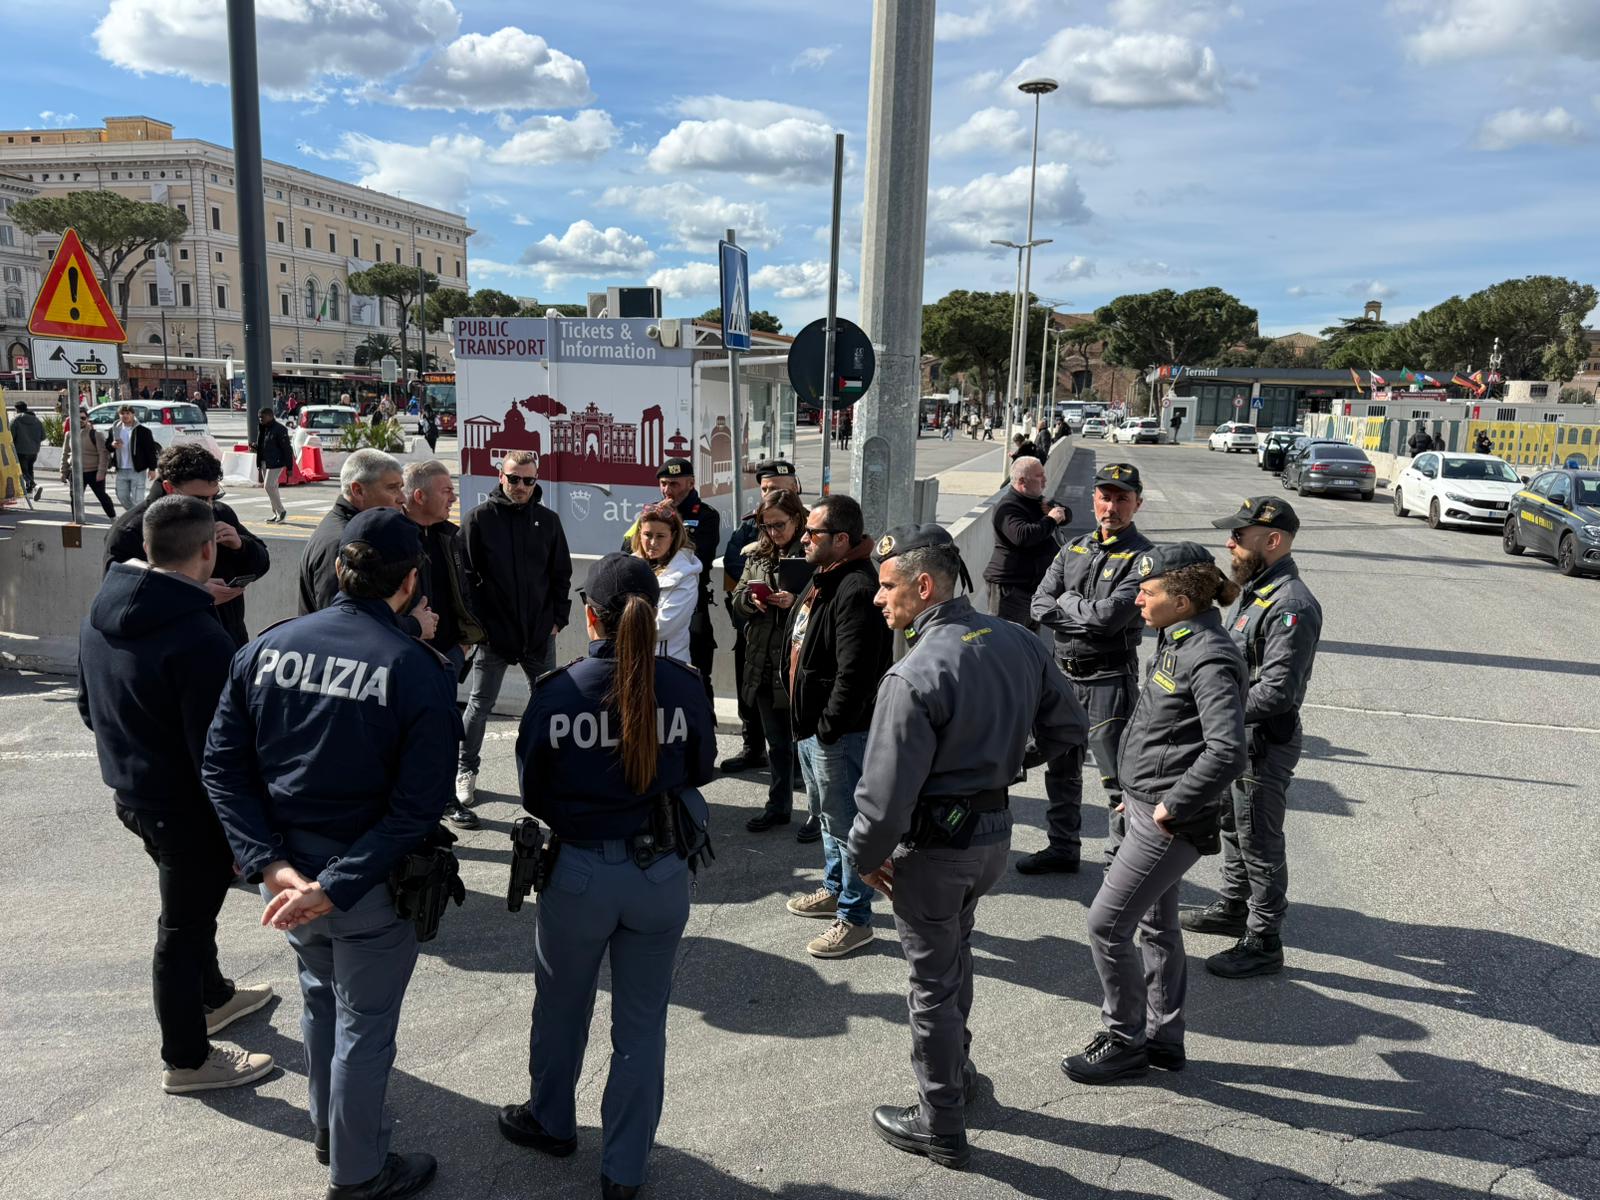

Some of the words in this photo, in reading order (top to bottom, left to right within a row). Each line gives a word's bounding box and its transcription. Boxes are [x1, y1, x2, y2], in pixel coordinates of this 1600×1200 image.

[458, 320, 509, 337] PUBLIC
[560, 321, 614, 340] Tickets
[620, 322, 632, 340] &
[458, 338, 546, 356] TRANSPORT
[560, 340, 657, 360] Information
[1184, 367, 1218, 377] Termini
[254, 648, 388, 707] POLIZIA
[549, 706, 688, 749] POLIA
